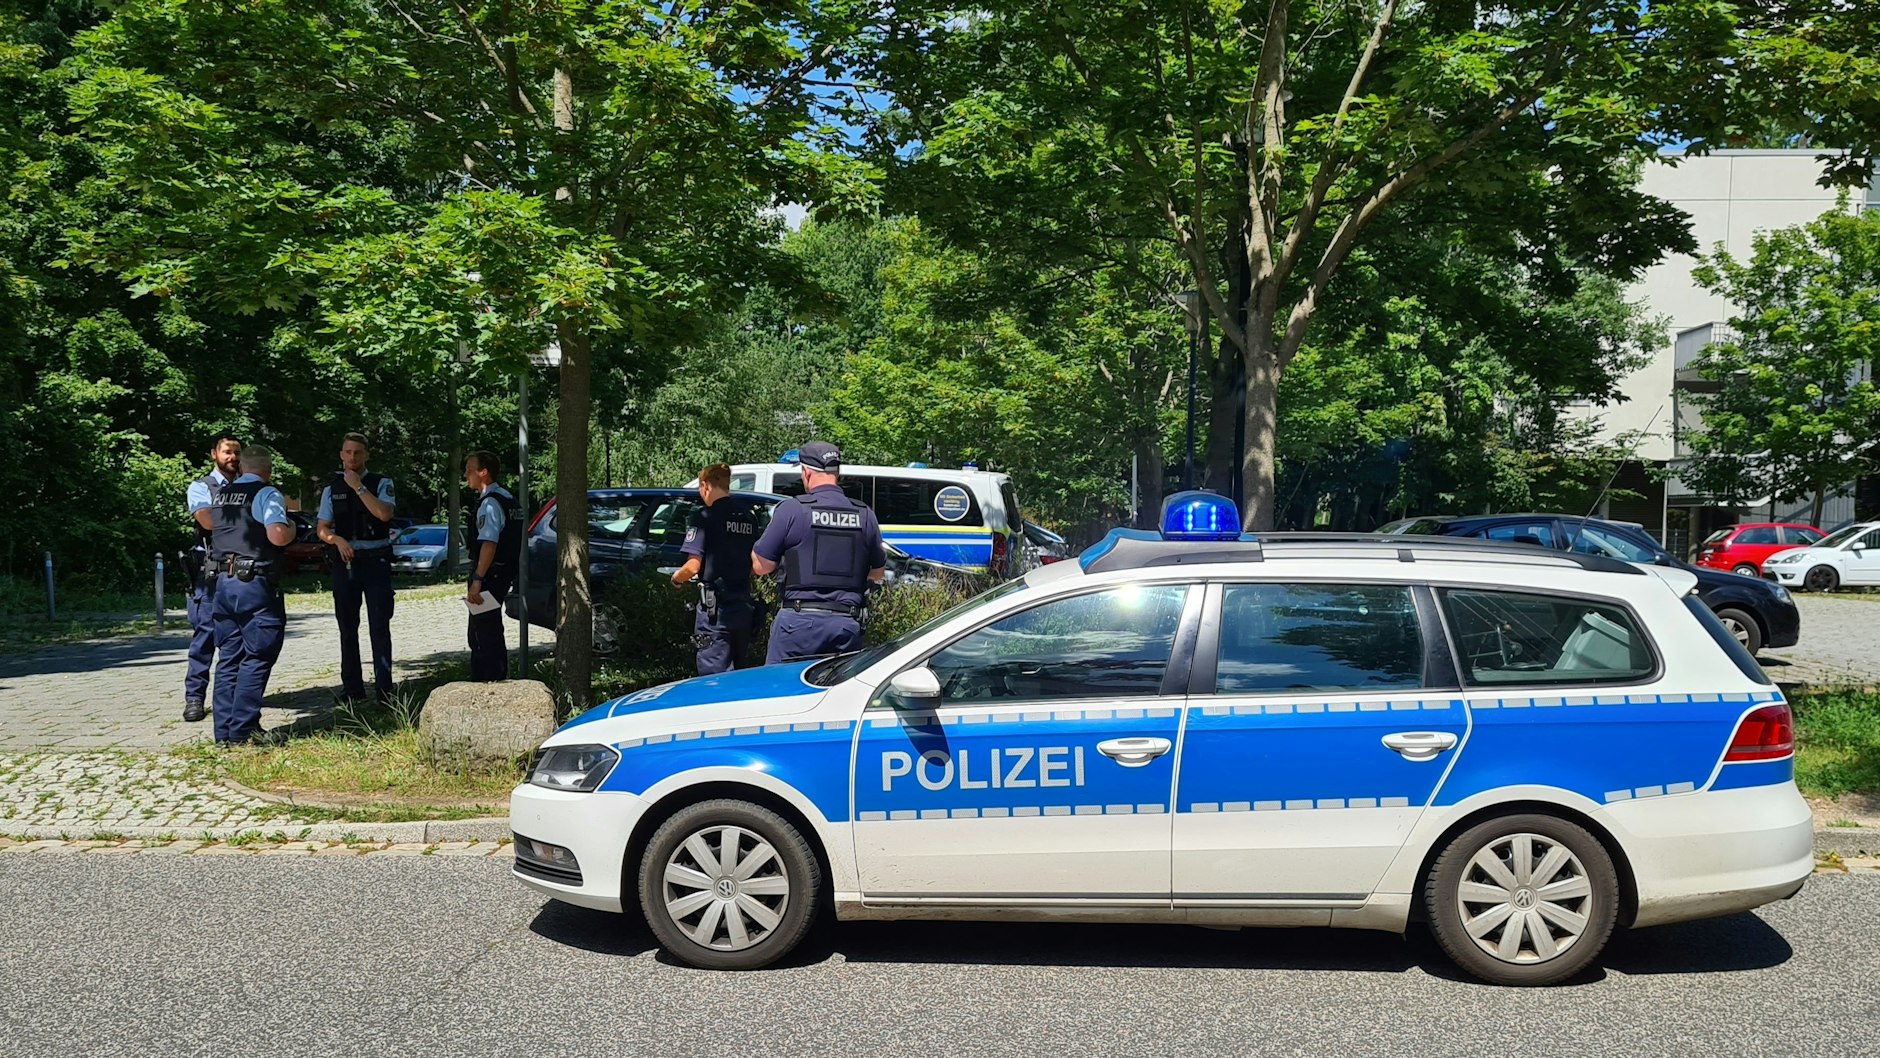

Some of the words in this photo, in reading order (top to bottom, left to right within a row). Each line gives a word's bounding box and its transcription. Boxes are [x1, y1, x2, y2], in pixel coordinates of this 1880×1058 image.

[213, 493, 248, 506] POLIZEI
[811, 511, 861, 527] POLIZEI
[726, 521, 753, 534] POLIZEI
[881, 746, 1085, 792] POLIZEI
